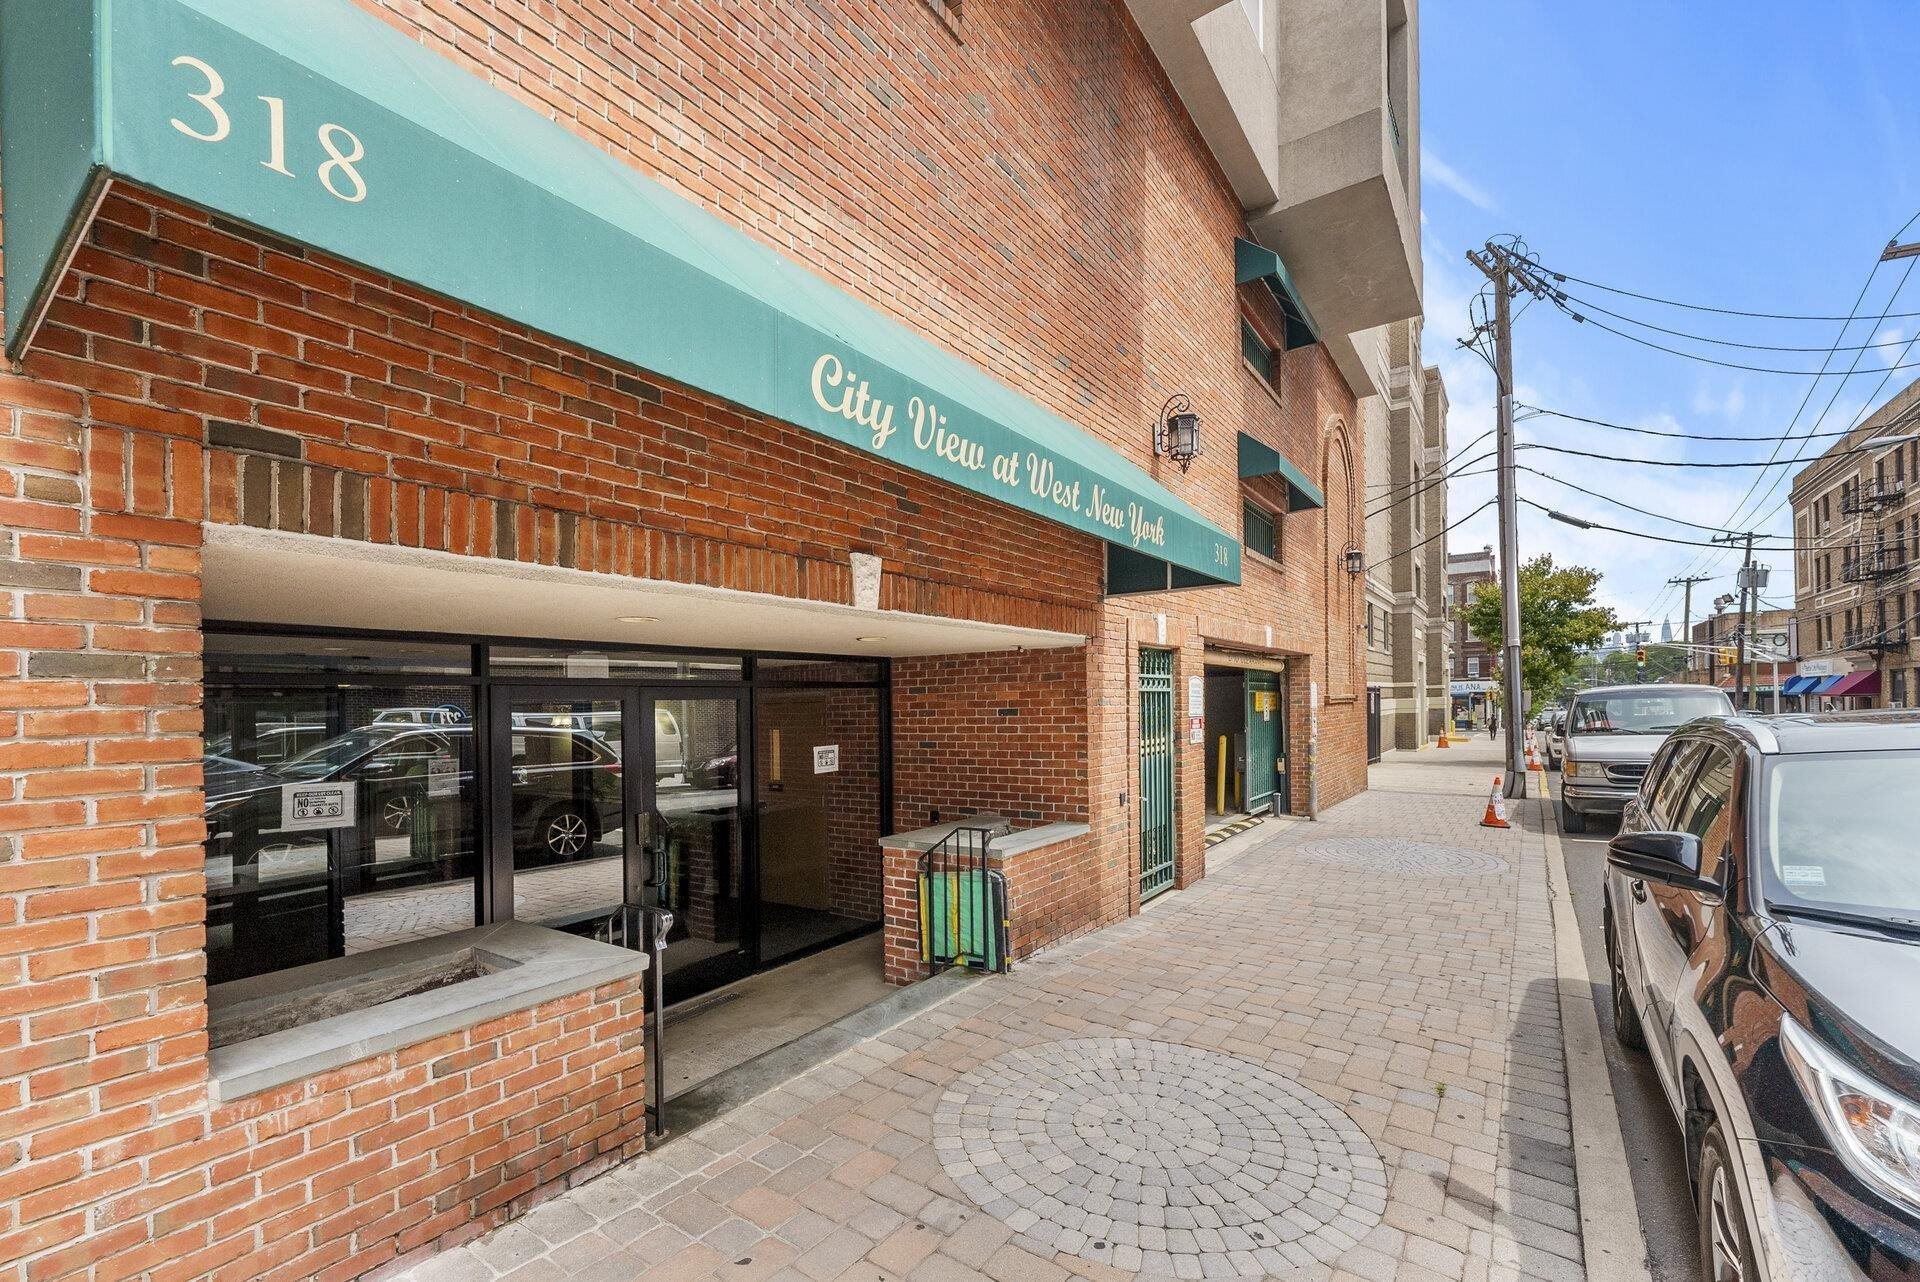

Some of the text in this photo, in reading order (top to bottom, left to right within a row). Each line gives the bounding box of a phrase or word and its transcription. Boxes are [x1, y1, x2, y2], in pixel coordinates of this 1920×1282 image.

[170, 55, 367, 203] 318
[811, 354, 1165, 547] City View at West New York
[1214, 542, 1229, 566] 318
[297, 797, 309, 808] NO
